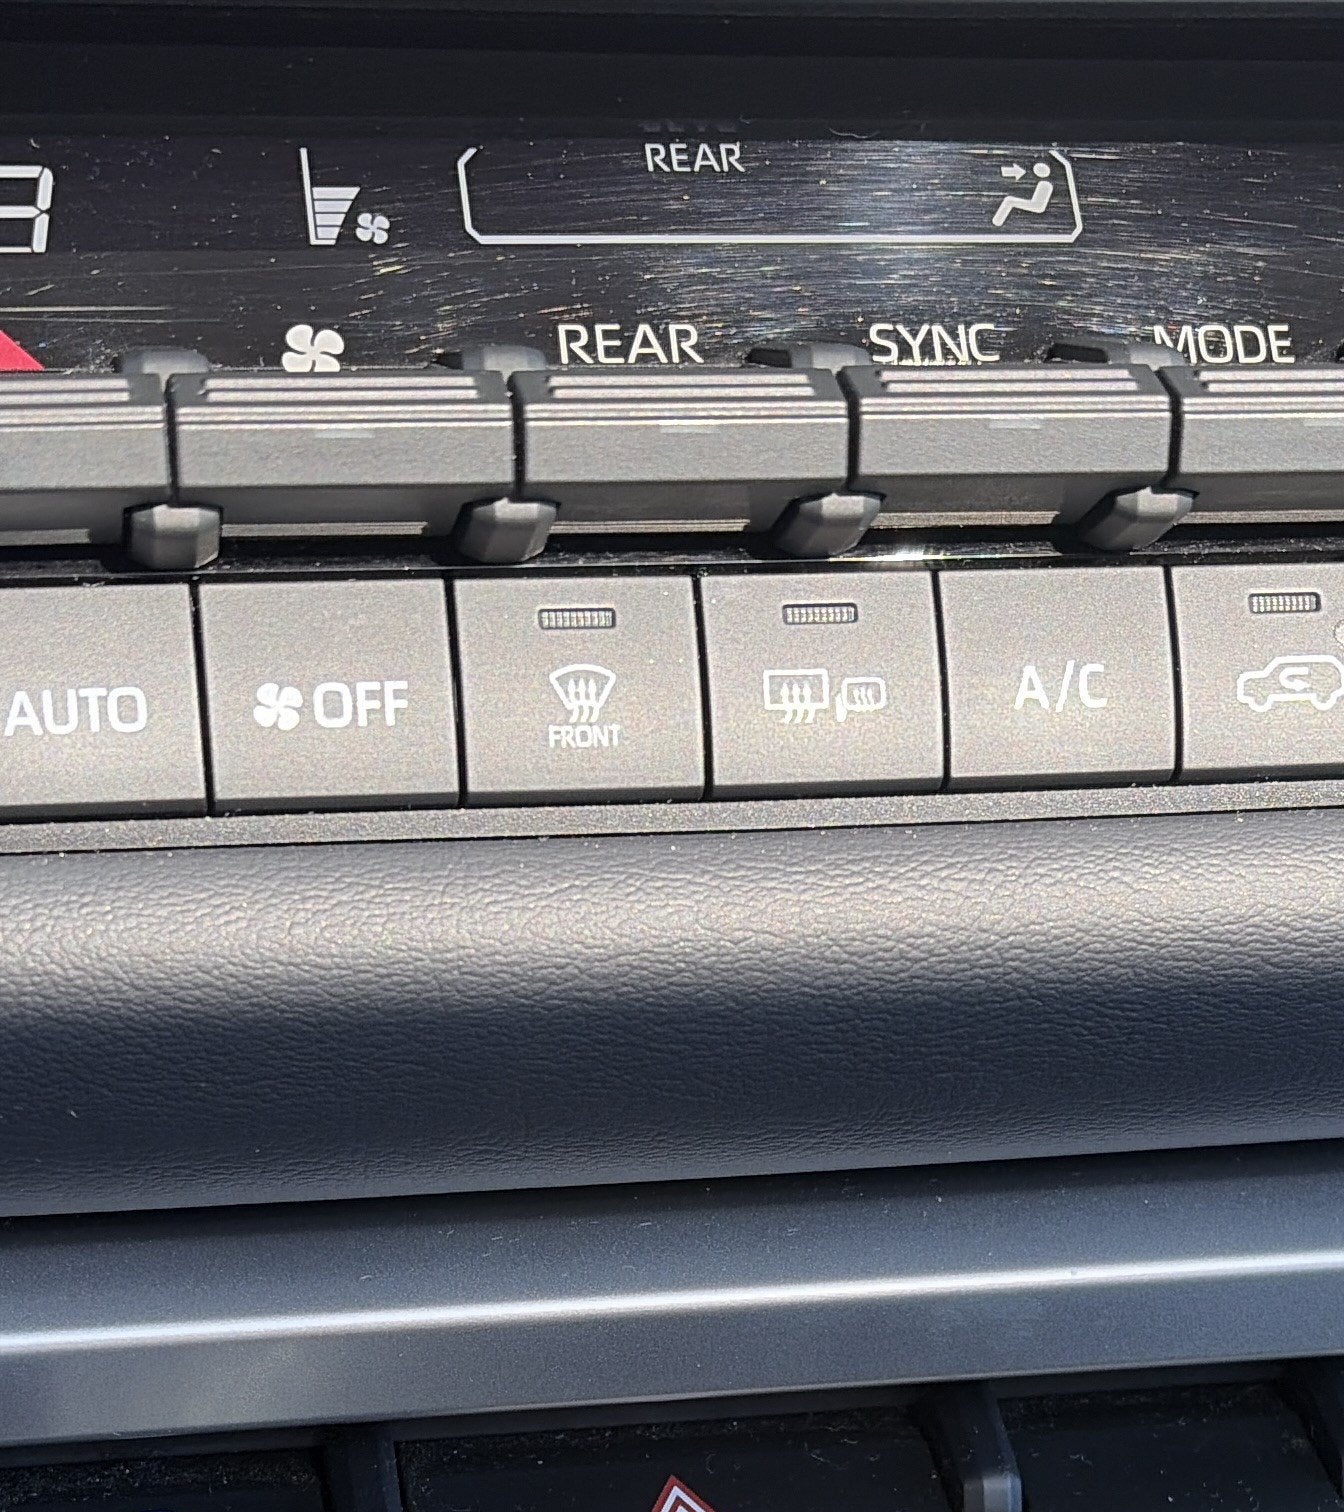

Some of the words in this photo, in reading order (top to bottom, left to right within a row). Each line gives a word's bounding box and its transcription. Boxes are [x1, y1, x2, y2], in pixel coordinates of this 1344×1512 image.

[644, 142, 745, 173] REAR
[557, 323, 704, 365] REAR
[869, 323, 1000, 365] SYNC
[1153, 324, 1295, 365] MODE
[312, 680, 409, 729] OFF
[1013, 660, 1109, 711] A/C
[2, 686, 149, 738] AUTO
[547, 722, 621, 749] FRONT
